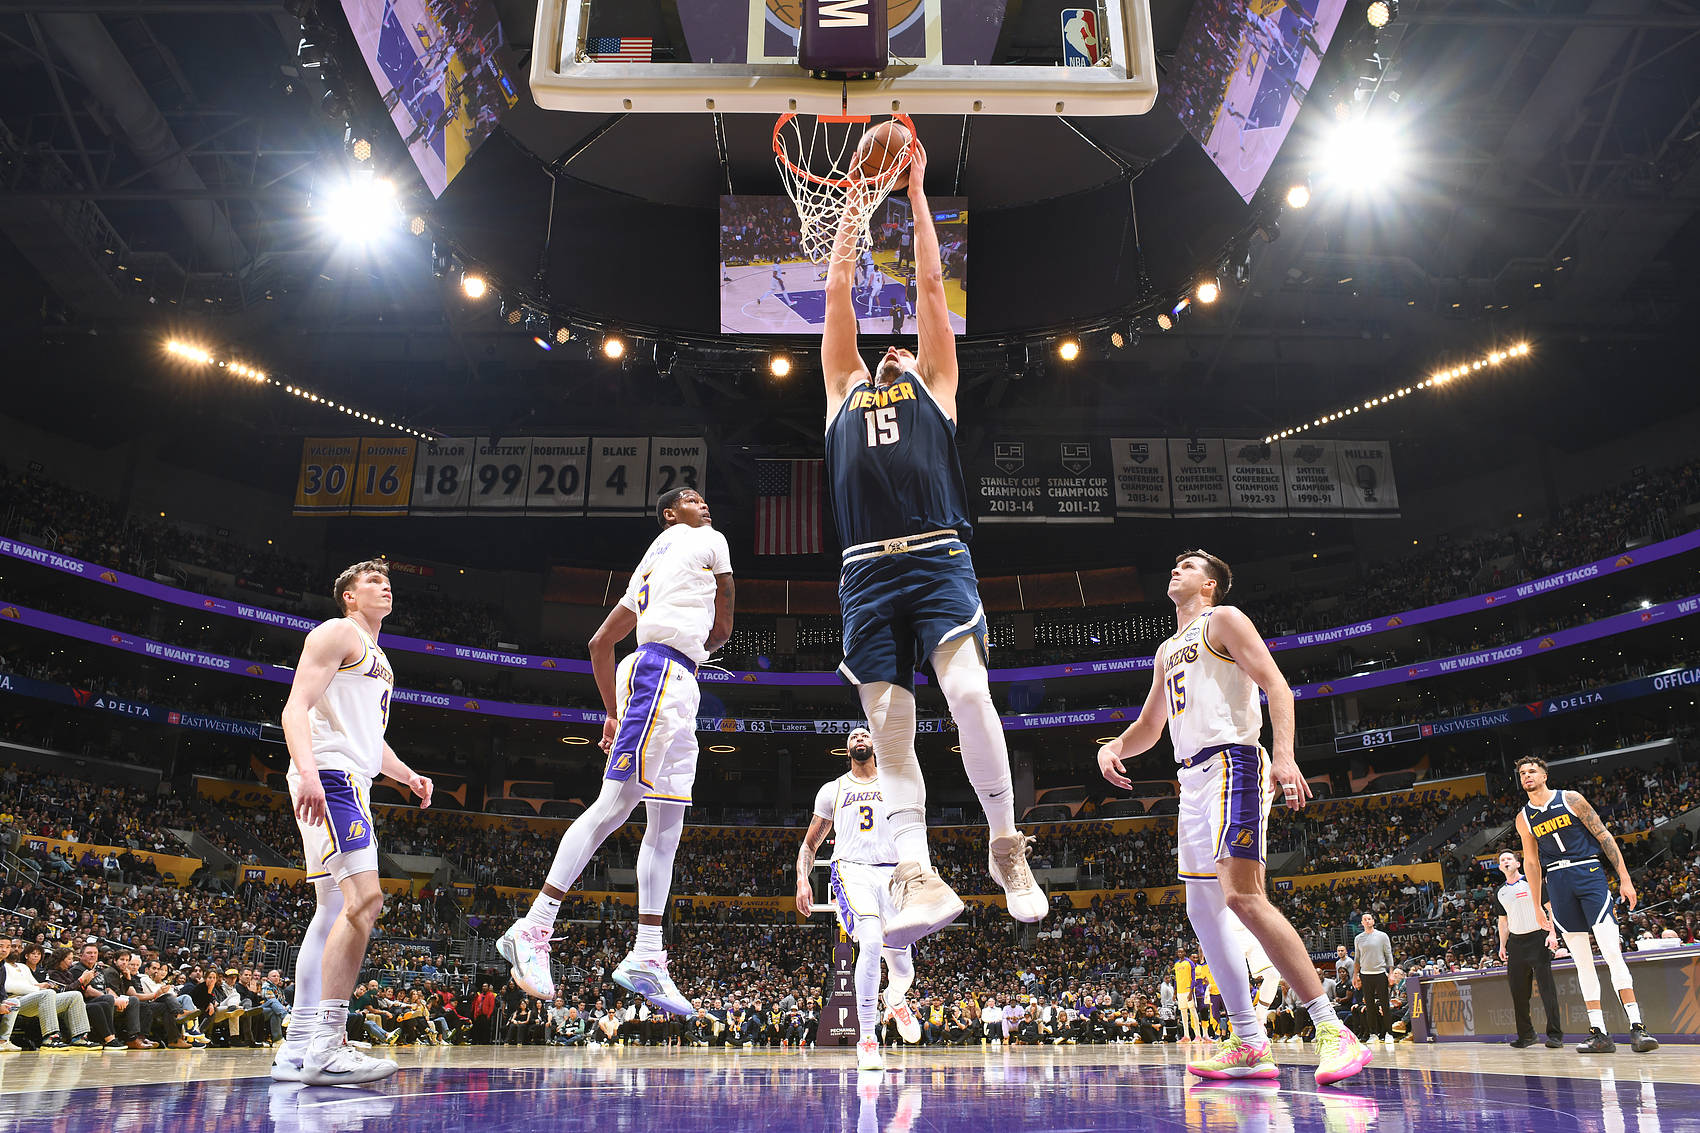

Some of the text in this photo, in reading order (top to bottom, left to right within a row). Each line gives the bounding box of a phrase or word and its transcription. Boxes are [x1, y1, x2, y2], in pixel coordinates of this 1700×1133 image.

[1070, 56, 1087, 67] NBA
[848, 382, 917, 412] DENVER
[864, 406, 900, 448] 15
[310, 446, 352, 457] VACHON
[367, 446, 408, 457] DIONNE
[428, 446, 465, 457] TAYLOR
[480, 446, 526, 457] GRETZKY
[534, 446, 586, 457] ROBITAILLE
[602, 446, 637, 457] BLAKE
[659, 446, 699, 457] BROWN
[1344, 450, 1384, 459] MILLER
[1122, 466, 1159, 474] WESTERN
[1180, 466, 1217, 474] WESTERN
[1235, 467, 1274, 475] CAMPBELL
[303, 464, 348, 496] 30
[364, 464, 400, 496] 16
[424, 464, 459, 496] 18
[479, 464, 523, 496] 99
[534, 464, 579, 496] 20
[605, 465, 628, 496] 4
[656, 465, 698, 496] 23
[980, 477, 1040, 487] STANLEY CUP
[1047, 478, 1108, 487] STANLEY CUP
[1231, 475, 1280, 483] CONFERENCE
[1295, 475, 1329, 483] DIVISION
[980, 486, 1041, 496] CHAMPIONS
[1047, 487, 1109, 497] CHAMPIONS
[1121, 483, 1163, 491] CHAMPIONS
[1178, 483, 1223, 491] CHAMPIONS
[1291, 483, 1335, 491] CHAMPIONS
[1240, 494, 1276, 503] 1992-93
[1297, 494, 1331, 503] 1990-91
[989, 500, 1034, 511] 2013-14
[1057, 501, 1101, 512] 2011-12
[13, 544, 48, 563] WANT
[50, 555, 84, 573] TACOS
[1517, 564, 1599, 597] WE WANT TACOS
[1677, 598, 1697, 613] WE
[238, 606, 316, 631] WE WANT TACOS
[1298, 635, 1314, 645] WE
[1315, 630, 1342, 642] WANT
[1343, 623, 1372, 637] TACOS
[145, 642, 231, 669] WE WANT TACOS
[456, 647, 471, 658] WE
[472, 649, 500, 662] WANT
[500, 654, 528, 666] TACOS
[1440, 659, 1458, 672] WE
[1458, 653, 1490, 667] WANT
[1490, 645, 1523, 661] TACOS
[1092, 663, 1108, 672] WE
[1108, 660, 1136, 671] WANT
[702, 672, 730, 682] TACOS
[421, 694, 451, 706] TACOS
[1167, 670, 1186, 719] 15
[1561, 692, 1603, 710] DELTA
[109, 700, 150, 718] DELTA
[380, 688, 391, 729] 4
[582, 712, 598, 722] WE
[1024, 712, 1096, 727] WE WANT TACOS
[750, 720, 766, 733] 63
[781, 723, 807, 734] Lakers
[821, 720, 851, 734] 25.9
[917, 720, 934, 732] 55
[1362, 730, 1393, 747] 8:31
[859, 805, 874, 832] 3
[1532, 813, 1573, 838] DENVER
[1552, 832, 1568, 853] 1
